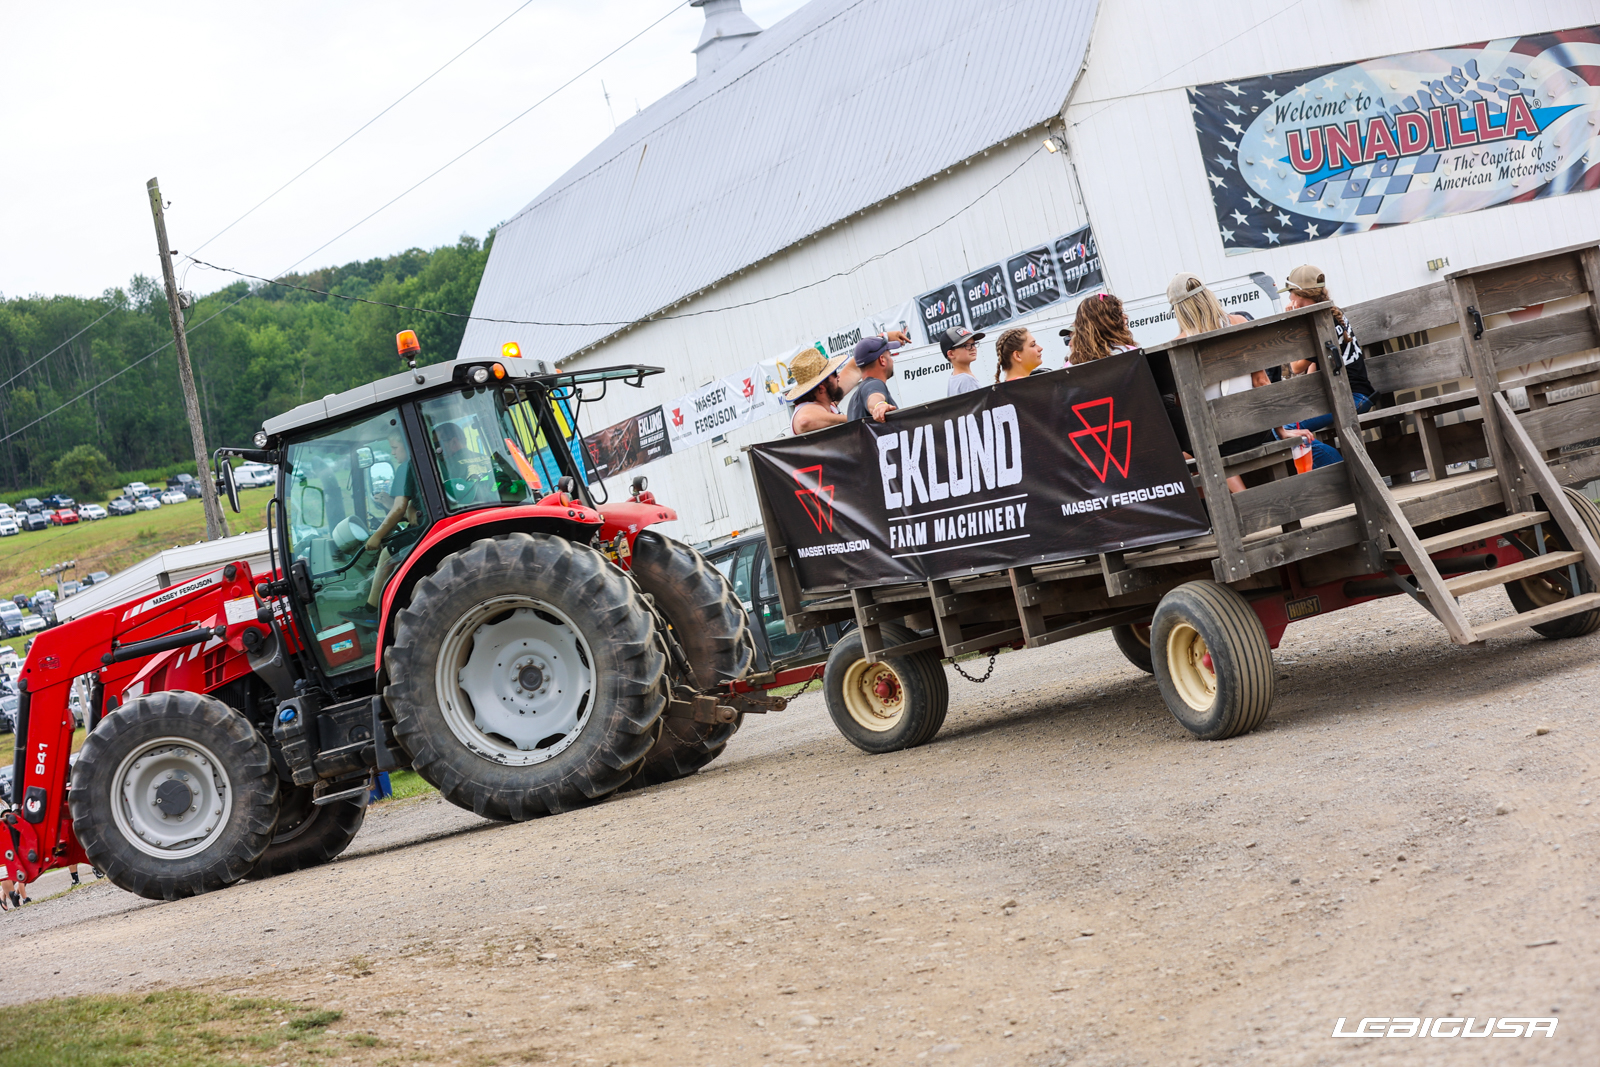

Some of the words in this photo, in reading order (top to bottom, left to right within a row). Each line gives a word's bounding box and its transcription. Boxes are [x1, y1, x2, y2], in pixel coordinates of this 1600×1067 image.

[1275, 99, 1347, 125] Welcome
[1355, 92, 1371, 112] to
[1285, 92, 1542, 175] UNADILLA
[1481, 145, 1526, 169] Capital
[1531, 140, 1544, 161] of
[1433, 172, 1493, 193] American
[1062, 246, 1077, 264] elf
[1014, 266, 1028, 283] elf
[968, 285, 982, 302] elf
[1016, 276, 1055, 301] MOTO
[1219, 290, 1260, 308] Y-RYDER
[925, 303, 939, 320] elf
[970, 294, 1007, 319] MOTO
[827, 327, 863, 354] Anderson
[694, 386, 728, 414] MASSEY
[637, 411, 664, 437] EKLUND
[694, 405, 738, 435] FERGUSON
[876, 403, 1023, 510] EKLUND
[1061, 496, 1109, 517] MASSEY
[1111, 481, 1186, 507] FERGUSON
[889, 521, 928, 549] FARM
[933, 502, 1028, 543] MACHINERY
[797, 544, 827, 558] MASSEY
[826, 538, 870, 555] FERGUSON
[152, 590, 178, 605] MASSEY
[179, 577, 213, 595] FERGUSON
[1288, 598, 1320, 619] HORST
[35, 742, 49, 775] 941
